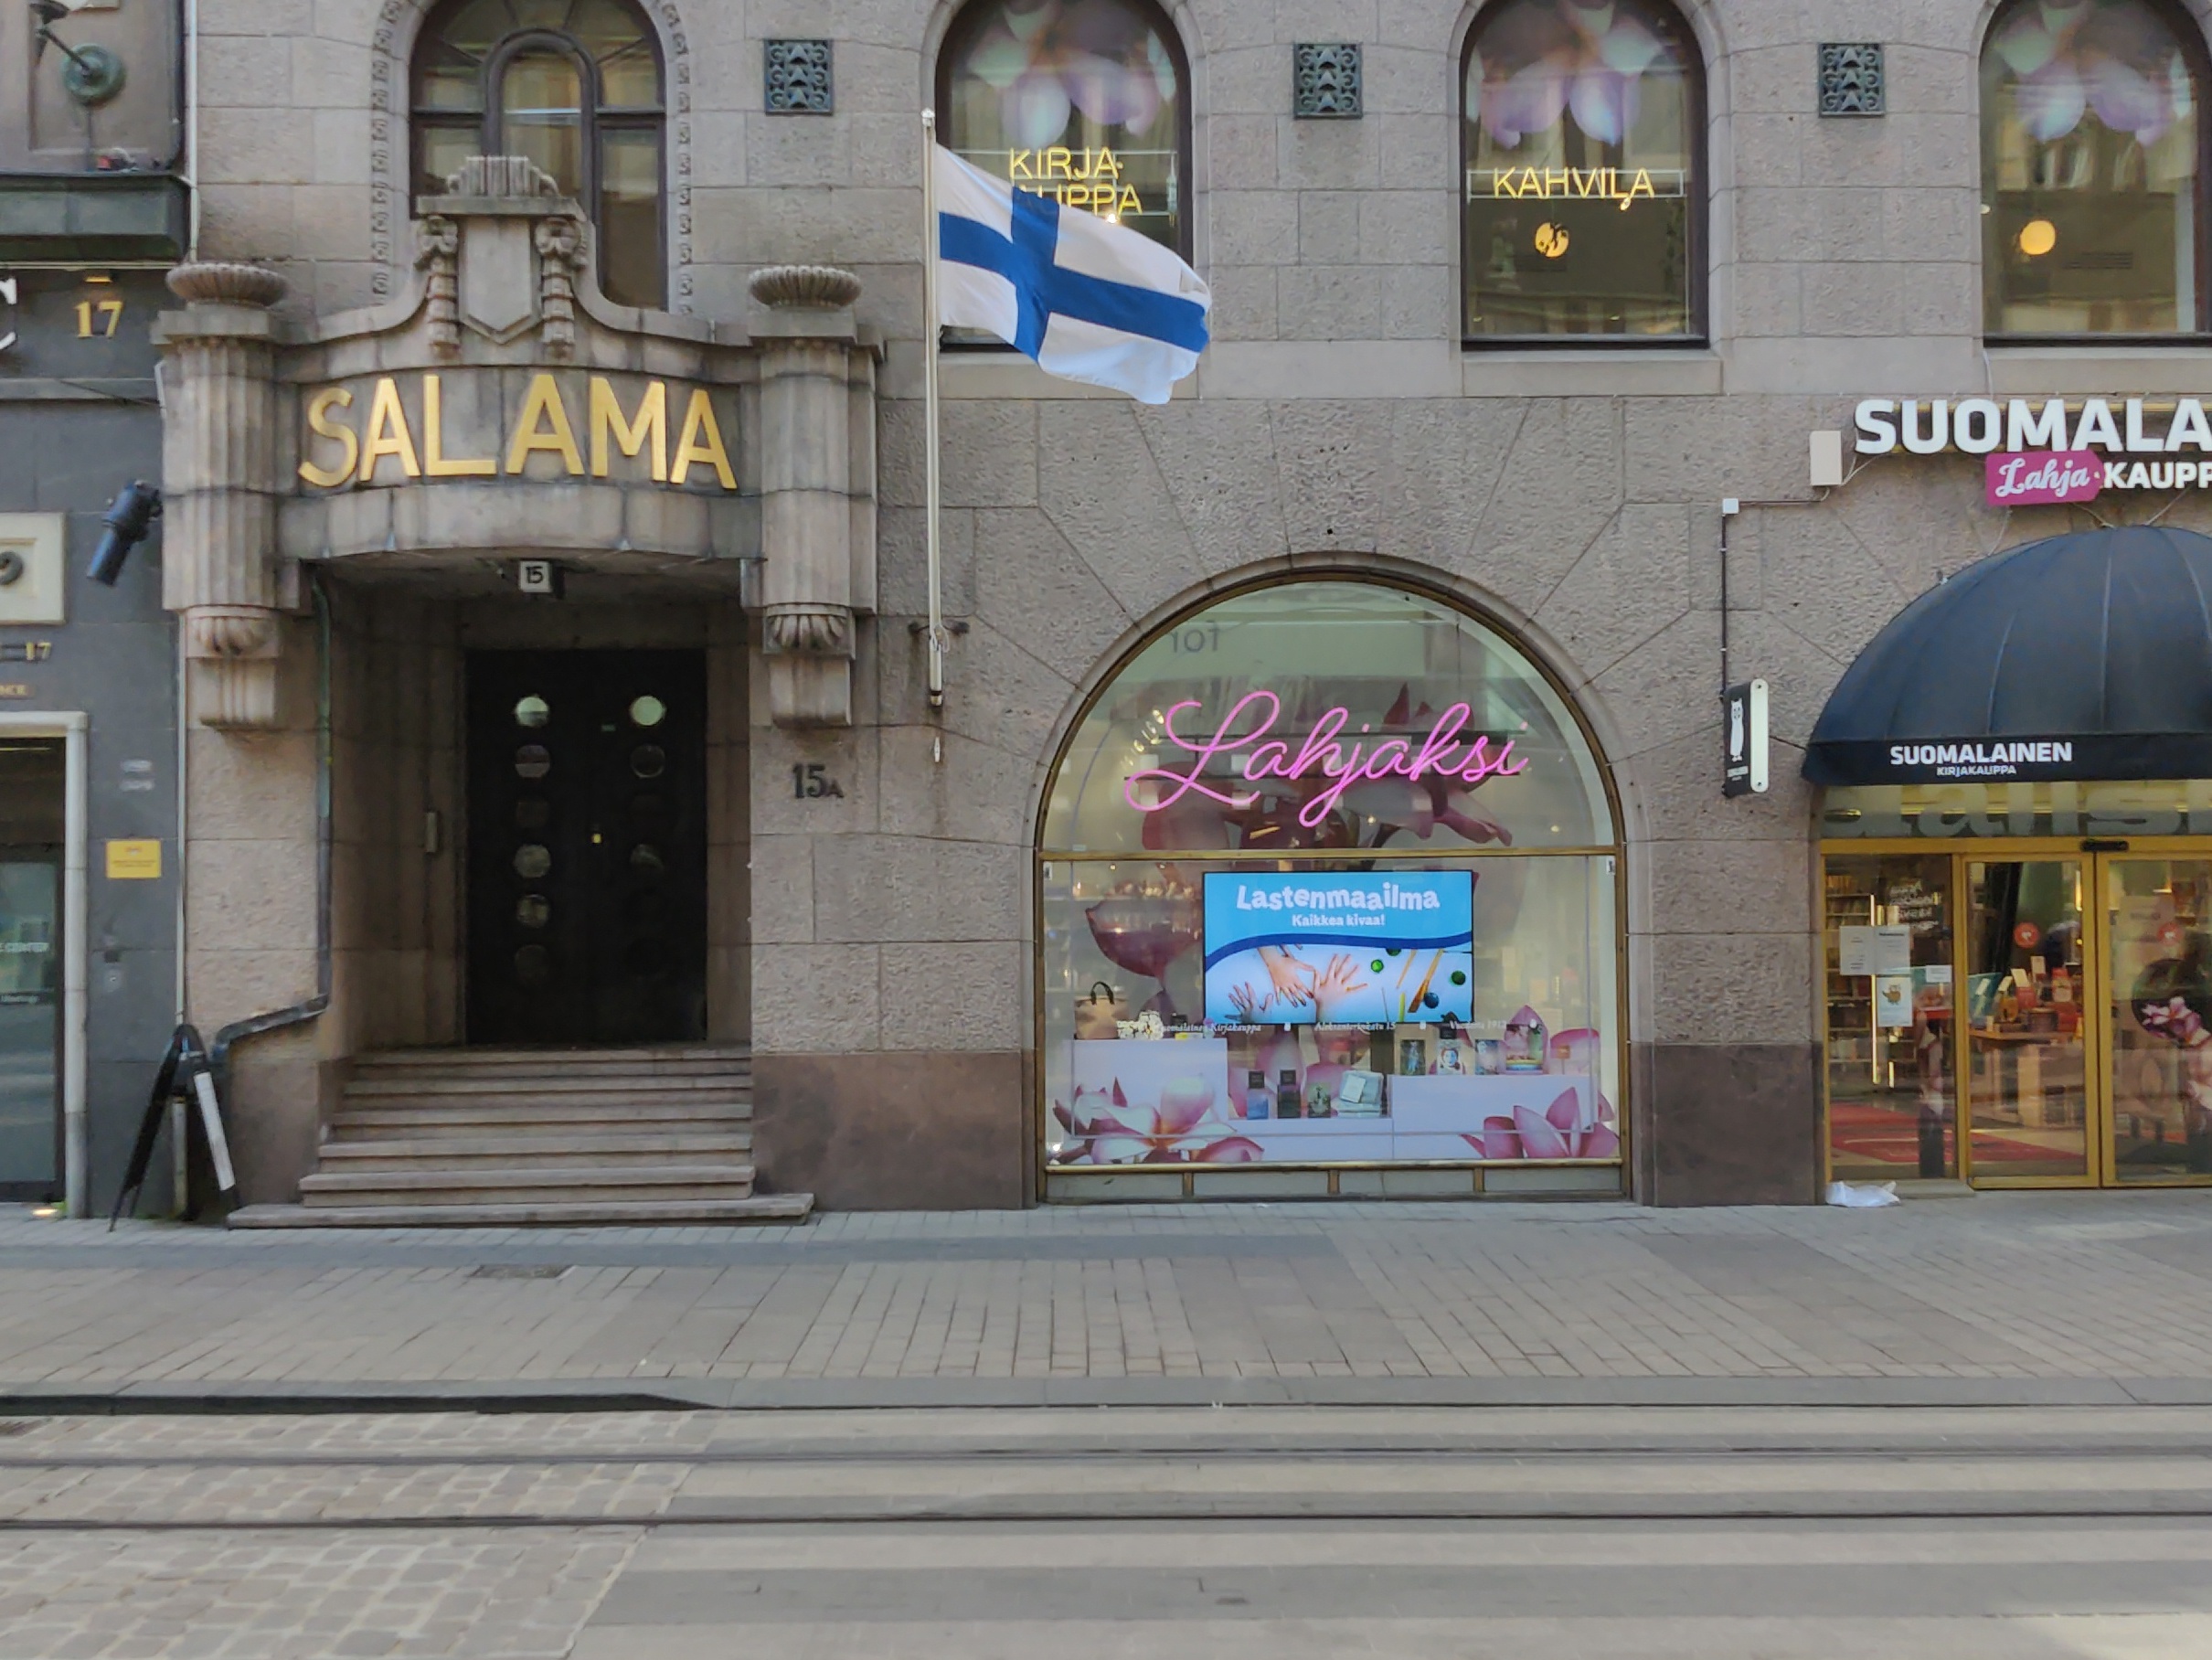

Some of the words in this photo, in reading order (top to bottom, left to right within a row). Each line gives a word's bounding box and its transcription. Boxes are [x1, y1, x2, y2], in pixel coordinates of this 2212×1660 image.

[1494, 166, 1655, 198] KAHVILA
[74, 300, 123, 339] 17
[297, 373, 738, 489] SALAMA
[1854, 399, 2212, 454] SUOMALA
[1994, 458, 2090, 499] Lahja
[2103, 461, 2212, 489] KAUPP
[526, 566, 544, 584] 15
[26, 642, 52, 661] 17
[1123, 690, 1530, 827] Lahjaksi
[1889, 741, 2073, 765] SUOMALAINEN
[1936, 765, 2016, 777] KIRJAKAUPPA
[1236, 881, 1441, 911] Lastenmaailma
[1292, 914, 1344, 927] Kaikkea
[1345, 914, 1386, 927] kivaa!
